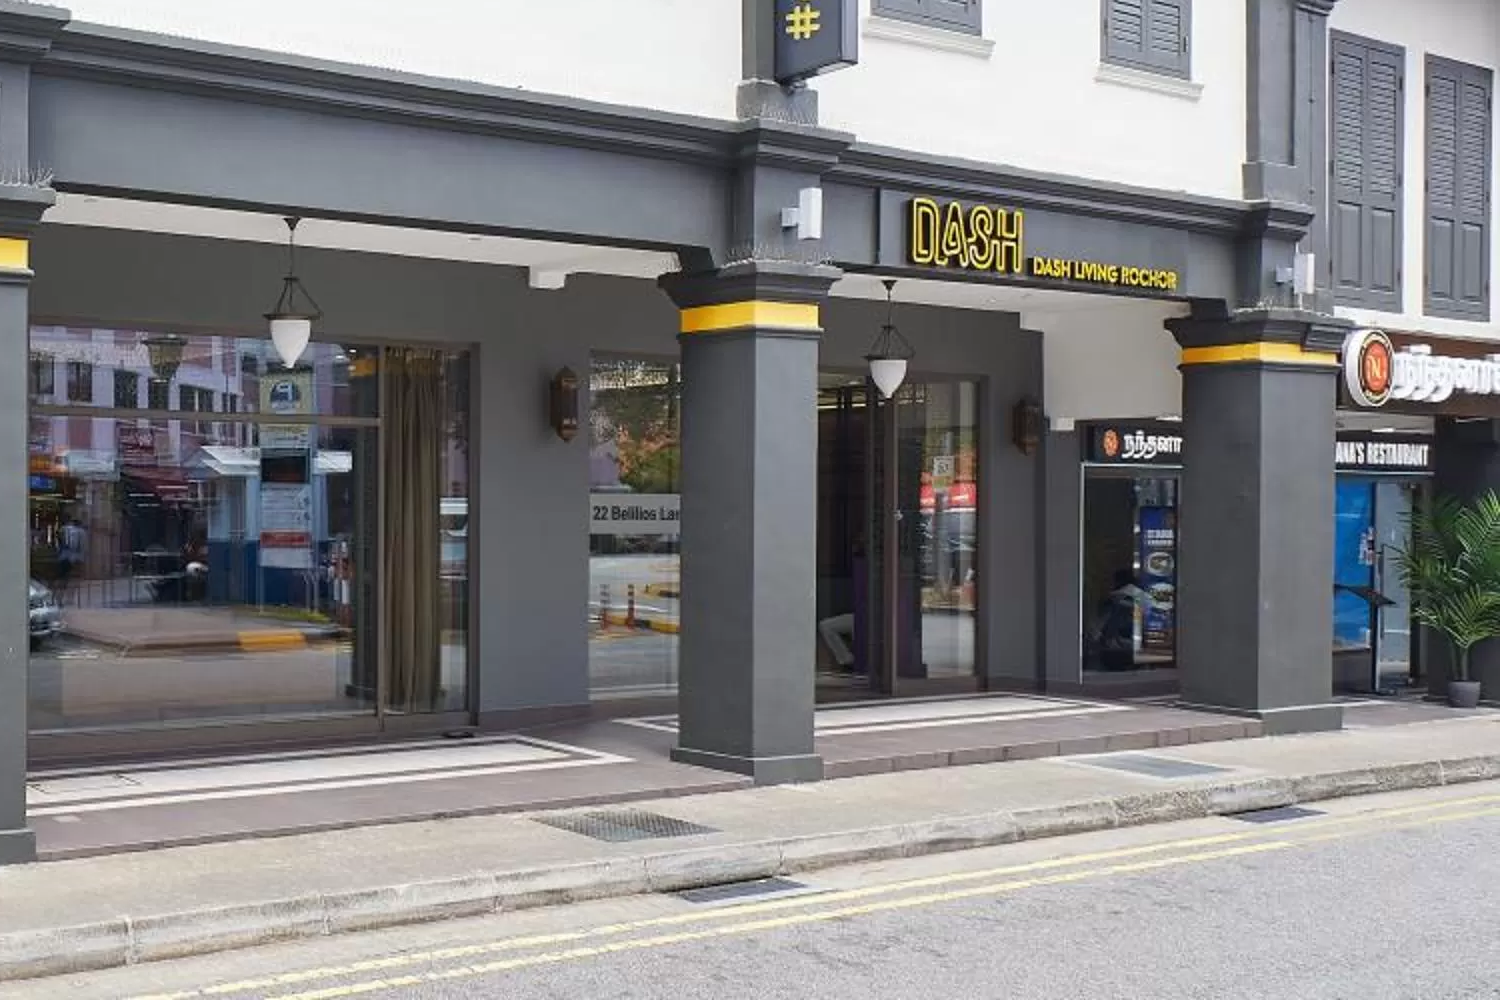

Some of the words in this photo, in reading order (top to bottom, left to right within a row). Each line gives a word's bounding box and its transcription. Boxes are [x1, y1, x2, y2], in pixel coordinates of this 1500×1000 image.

[912, 197, 1025, 274] DASH
[1033, 256, 1071, 279] DASH
[1075, 261, 1119, 284] LIVING
[1121, 265, 1177, 290] ROCHOR
[1335, 441, 1365, 465] ANA'S
[1367, 443, 1429, 467] RESTAURANT
[593, 504, 609, 521] 22
